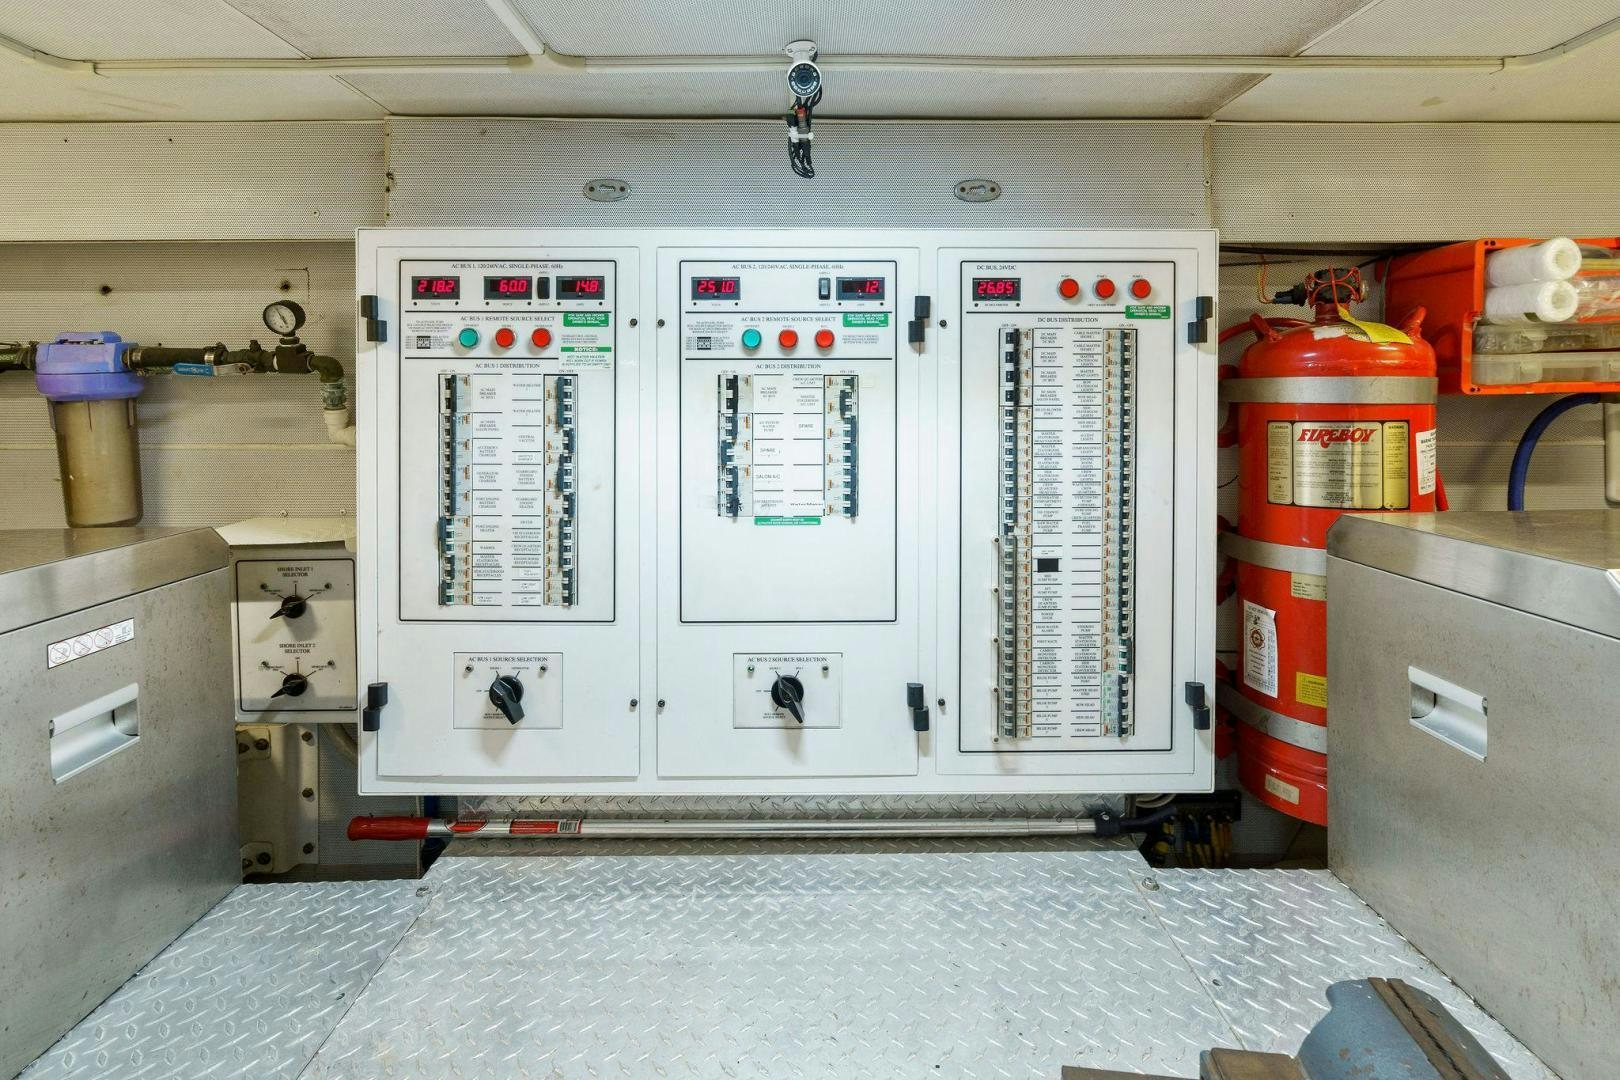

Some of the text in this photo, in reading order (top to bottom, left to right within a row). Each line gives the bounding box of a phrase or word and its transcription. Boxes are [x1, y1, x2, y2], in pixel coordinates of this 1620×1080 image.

[498, 280, 528, 292] 60.0
[576, 280, 599, 292] 14.8
[1297, 428, 1377, 448] FIREBOY
